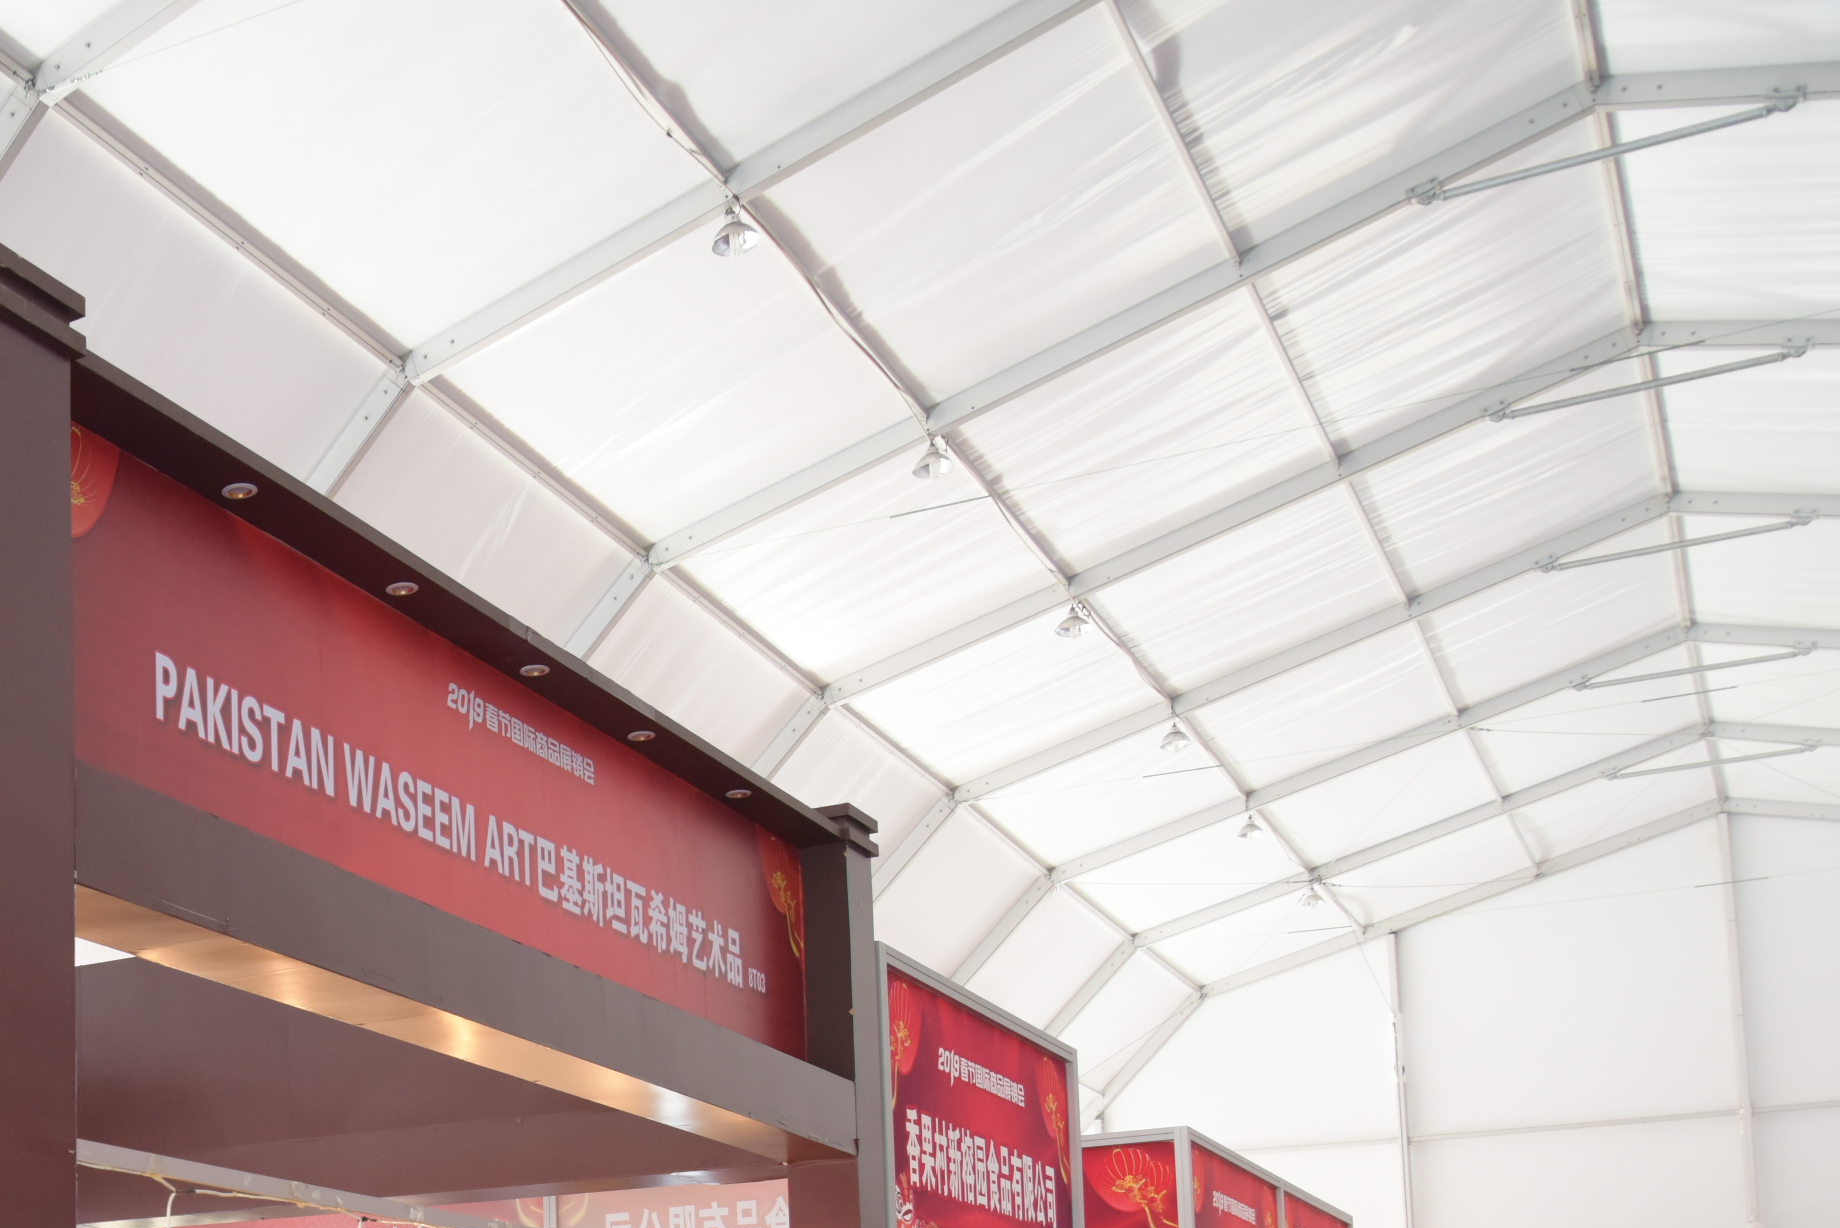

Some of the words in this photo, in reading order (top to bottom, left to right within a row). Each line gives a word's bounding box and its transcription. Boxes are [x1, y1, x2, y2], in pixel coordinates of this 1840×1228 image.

[446, 682, 596, 786] 2019春节国际商品展销会
[155, 650, 336, 798] PAKISTAN
[344, 742, 477, 863] WASEEM
[536, 835, 744, 989] 巴基斯坦瓦希姆艺术品
[748, 967, 766, 994] 8T03
